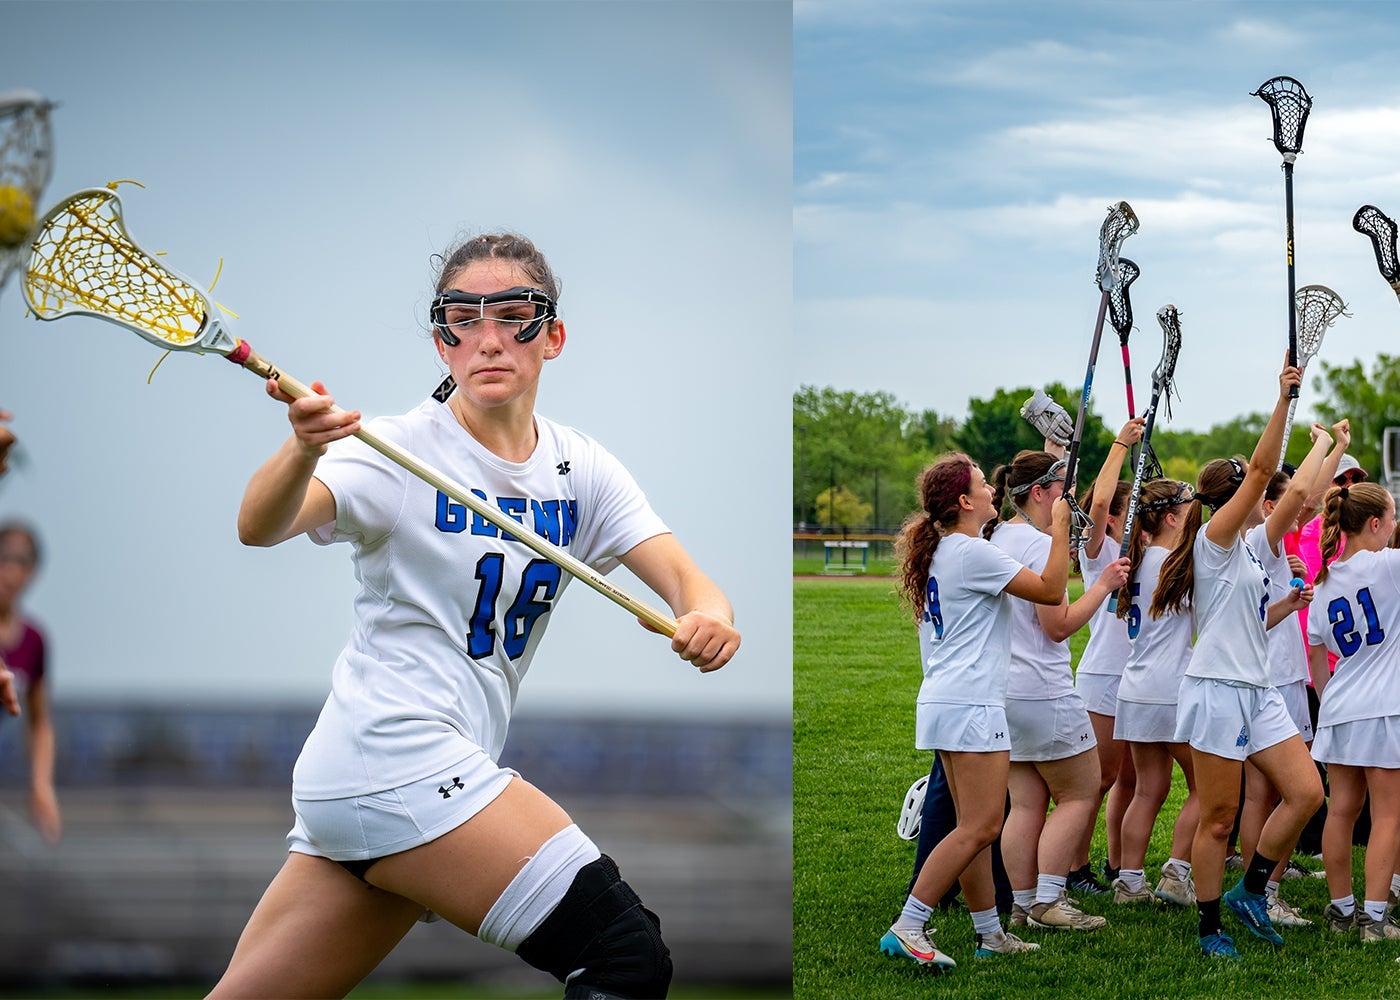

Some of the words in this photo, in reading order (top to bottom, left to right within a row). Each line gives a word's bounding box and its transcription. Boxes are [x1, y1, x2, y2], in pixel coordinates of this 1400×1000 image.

[435, 488, 577, 547] GLENN
[1124, 499, 1137, 535] UNDER
[1132, 453, 1147, 498] ARMOUR
[466, 552, 562, 662] 16
[1327, 586, 1386, 658] 21
